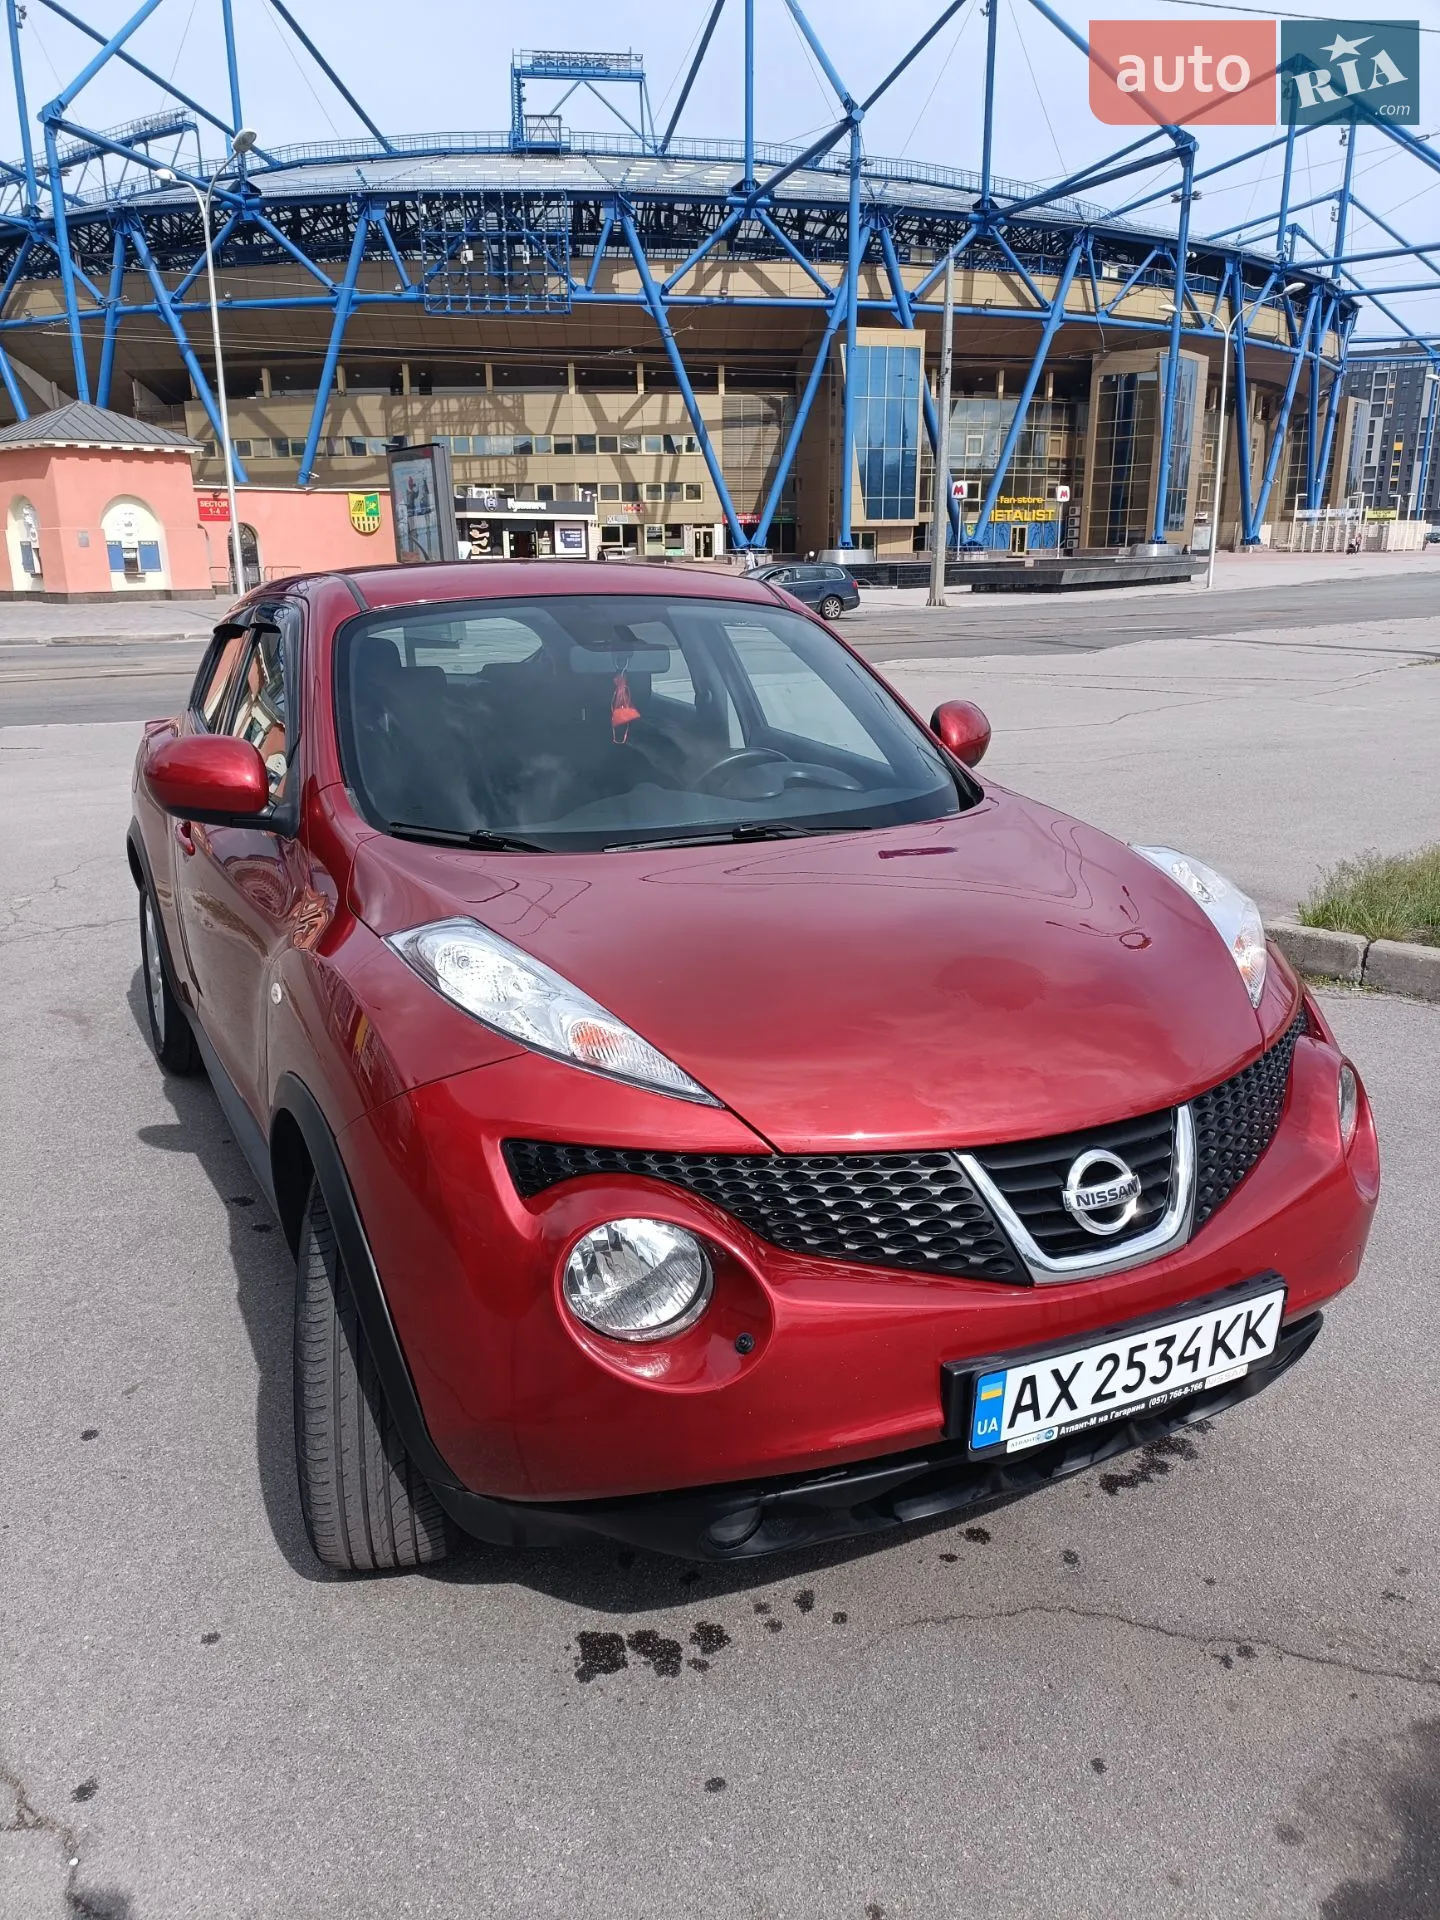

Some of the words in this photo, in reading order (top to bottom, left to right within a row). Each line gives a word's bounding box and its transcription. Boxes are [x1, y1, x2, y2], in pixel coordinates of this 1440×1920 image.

[199, 500, 229, 508] SECTOR
[1075, 1181, 1138, 1207] NISSAN
[1007, 1360, 1084, 1429] AX
[1091, 1325, 1203, 1404] 2534
[1208, 1302, 1275, 1367] KK
[1098, 1414, 1109, 1424] на
[1109, 1402, 1146, 1419] Гагарина
[1148, 1394, 1168, 1408] (057)
[1169, 1381, 1204, 1400] 766-8-766
[977, 1416, 999, 1436] UA
